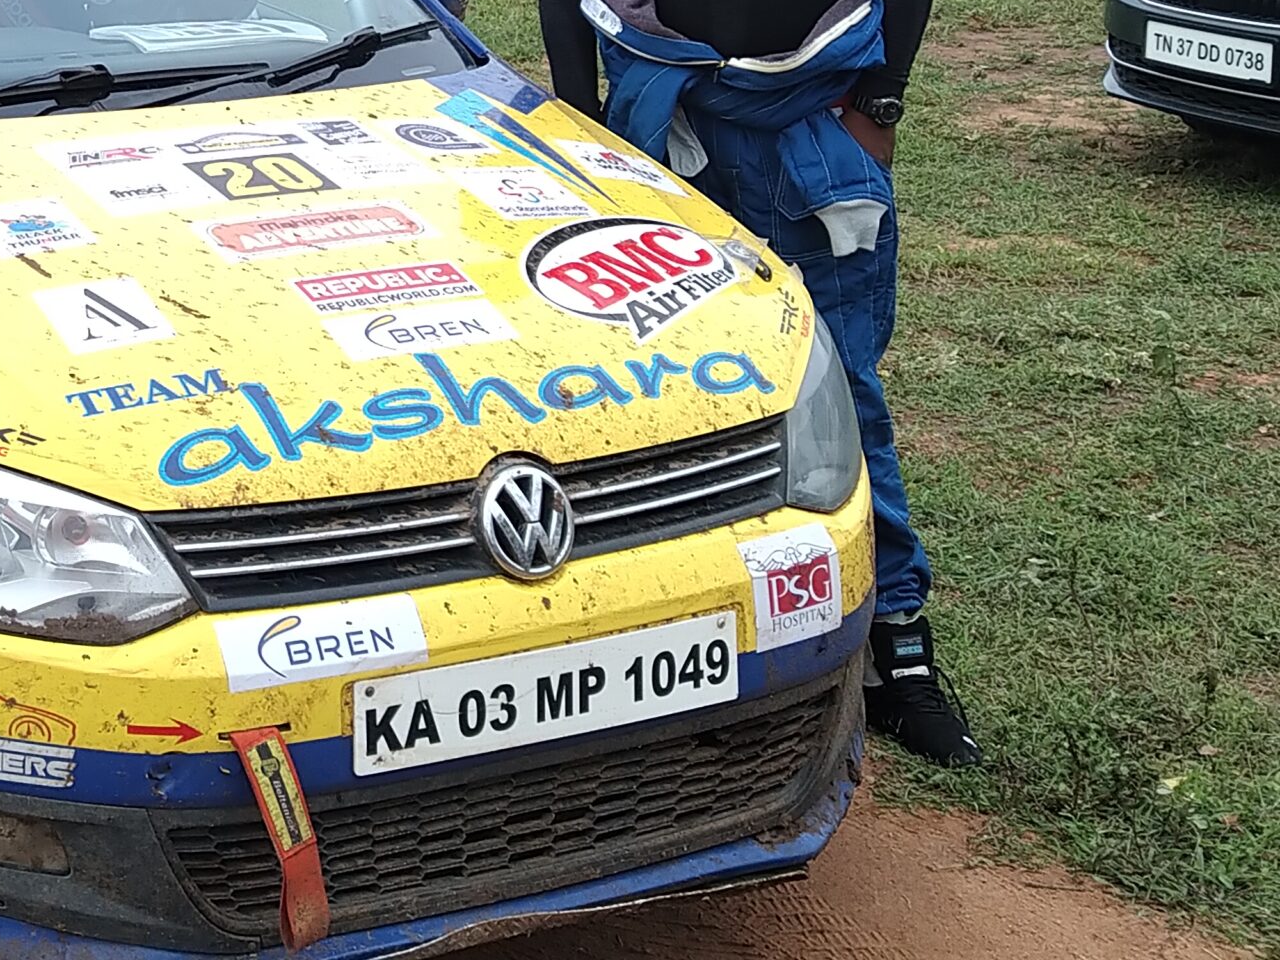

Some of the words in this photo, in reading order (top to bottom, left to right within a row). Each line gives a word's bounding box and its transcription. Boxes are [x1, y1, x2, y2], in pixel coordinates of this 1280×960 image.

[1153, 33, 1172, 54] TN
[1176, 38, 1193, 58] 37
[1197, 41, 1220, 63] DD
[1224, 48, 1265, 71] 0738
[203, 157, 325, 198] 20
[7, 233, 82, 249] THUNDER
[16, 228, 63, 240] BLACK
[258, 213, 360, 232] Mahindra
[542, 227, 713, 310] BMC
[316, 284, 478, 313] REPUBLICWORLD.COM
[626, 289, 688, 340] Air
[672, 269, 733, 301] Filter
[388, 318, 491, 344] BREN
[65, 368, 236, 417] TEAM
[158, 352, 776, 487] akshara
[767, 564, 832, 615] PSG
[771, 603, 835, 633] HOSPITALS
[285, 625, 396, 666] BREN
[364, 701, 440, 757] KA
[459, 684, 518, 738] 03
[536, 665, 607, 723] MP
[624, 638, 730, 703] 1049
